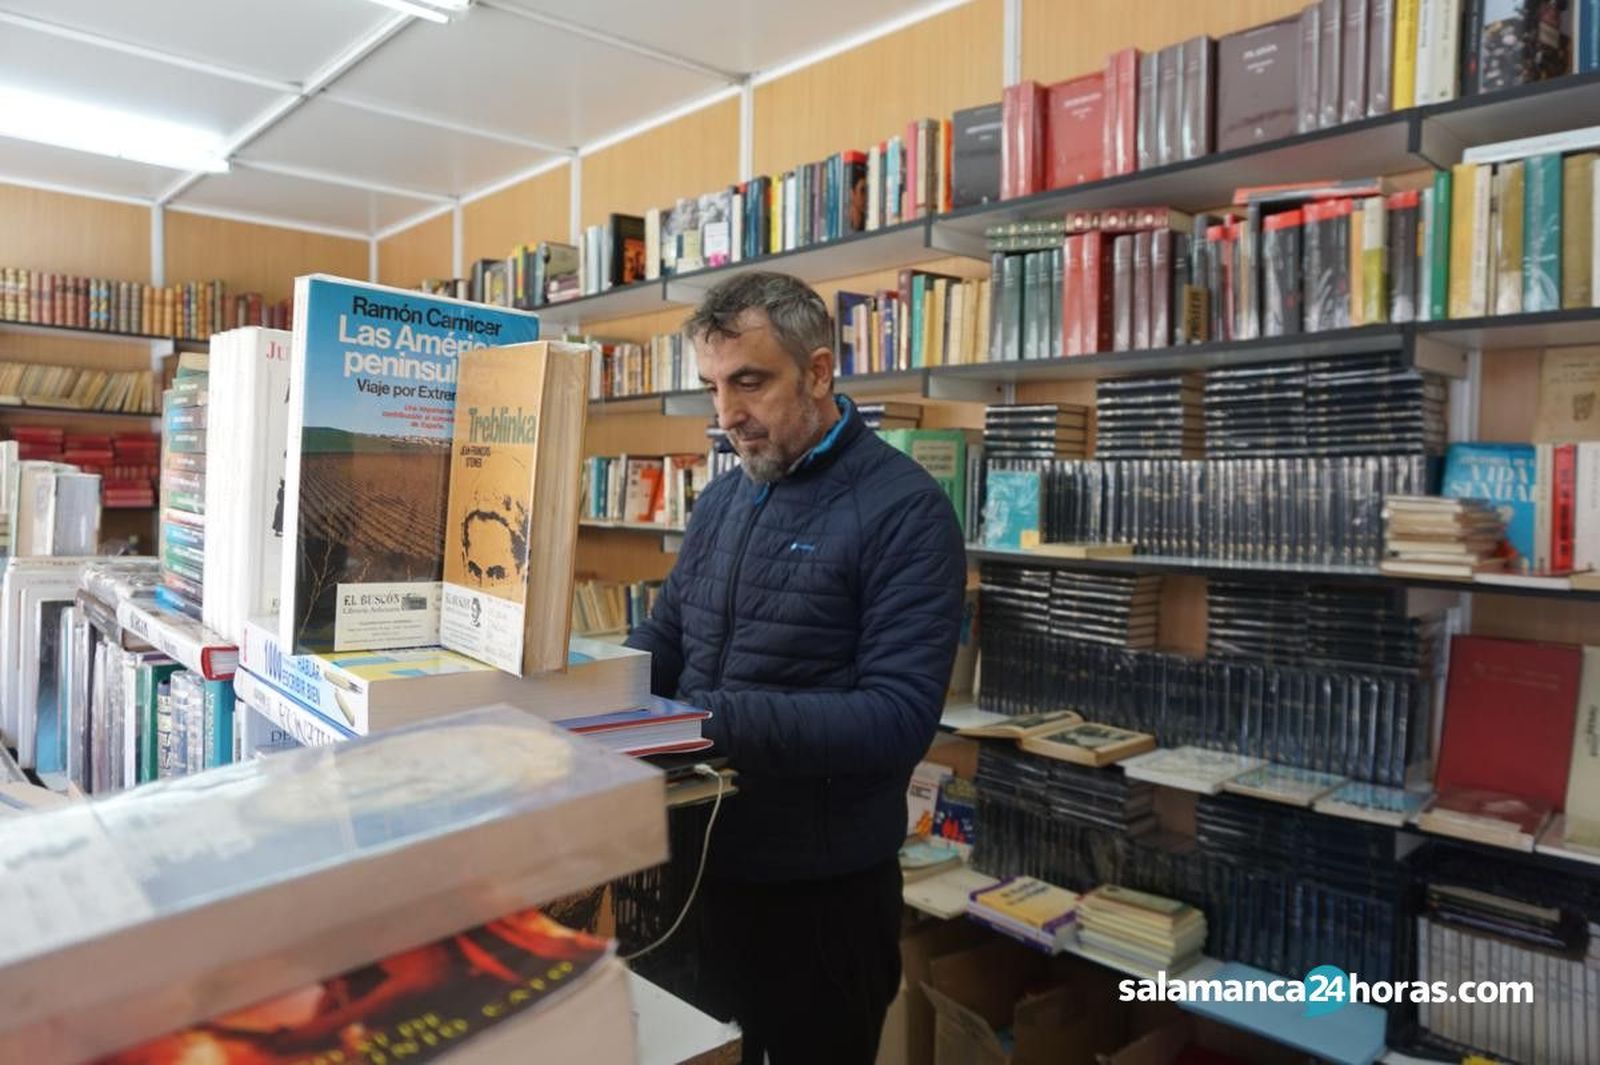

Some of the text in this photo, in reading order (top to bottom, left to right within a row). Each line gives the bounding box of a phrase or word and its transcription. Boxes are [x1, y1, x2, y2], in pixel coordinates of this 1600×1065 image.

[339, 314, 391, 349] Las
[353, 296, 502, 337] Ramón Carnicer
[356, 378, 390, 397] Viaje
[393, 385, 416, 398] por
[468, 406, 537, 444] Treblinka
[343, 594, 357, 606] EL
